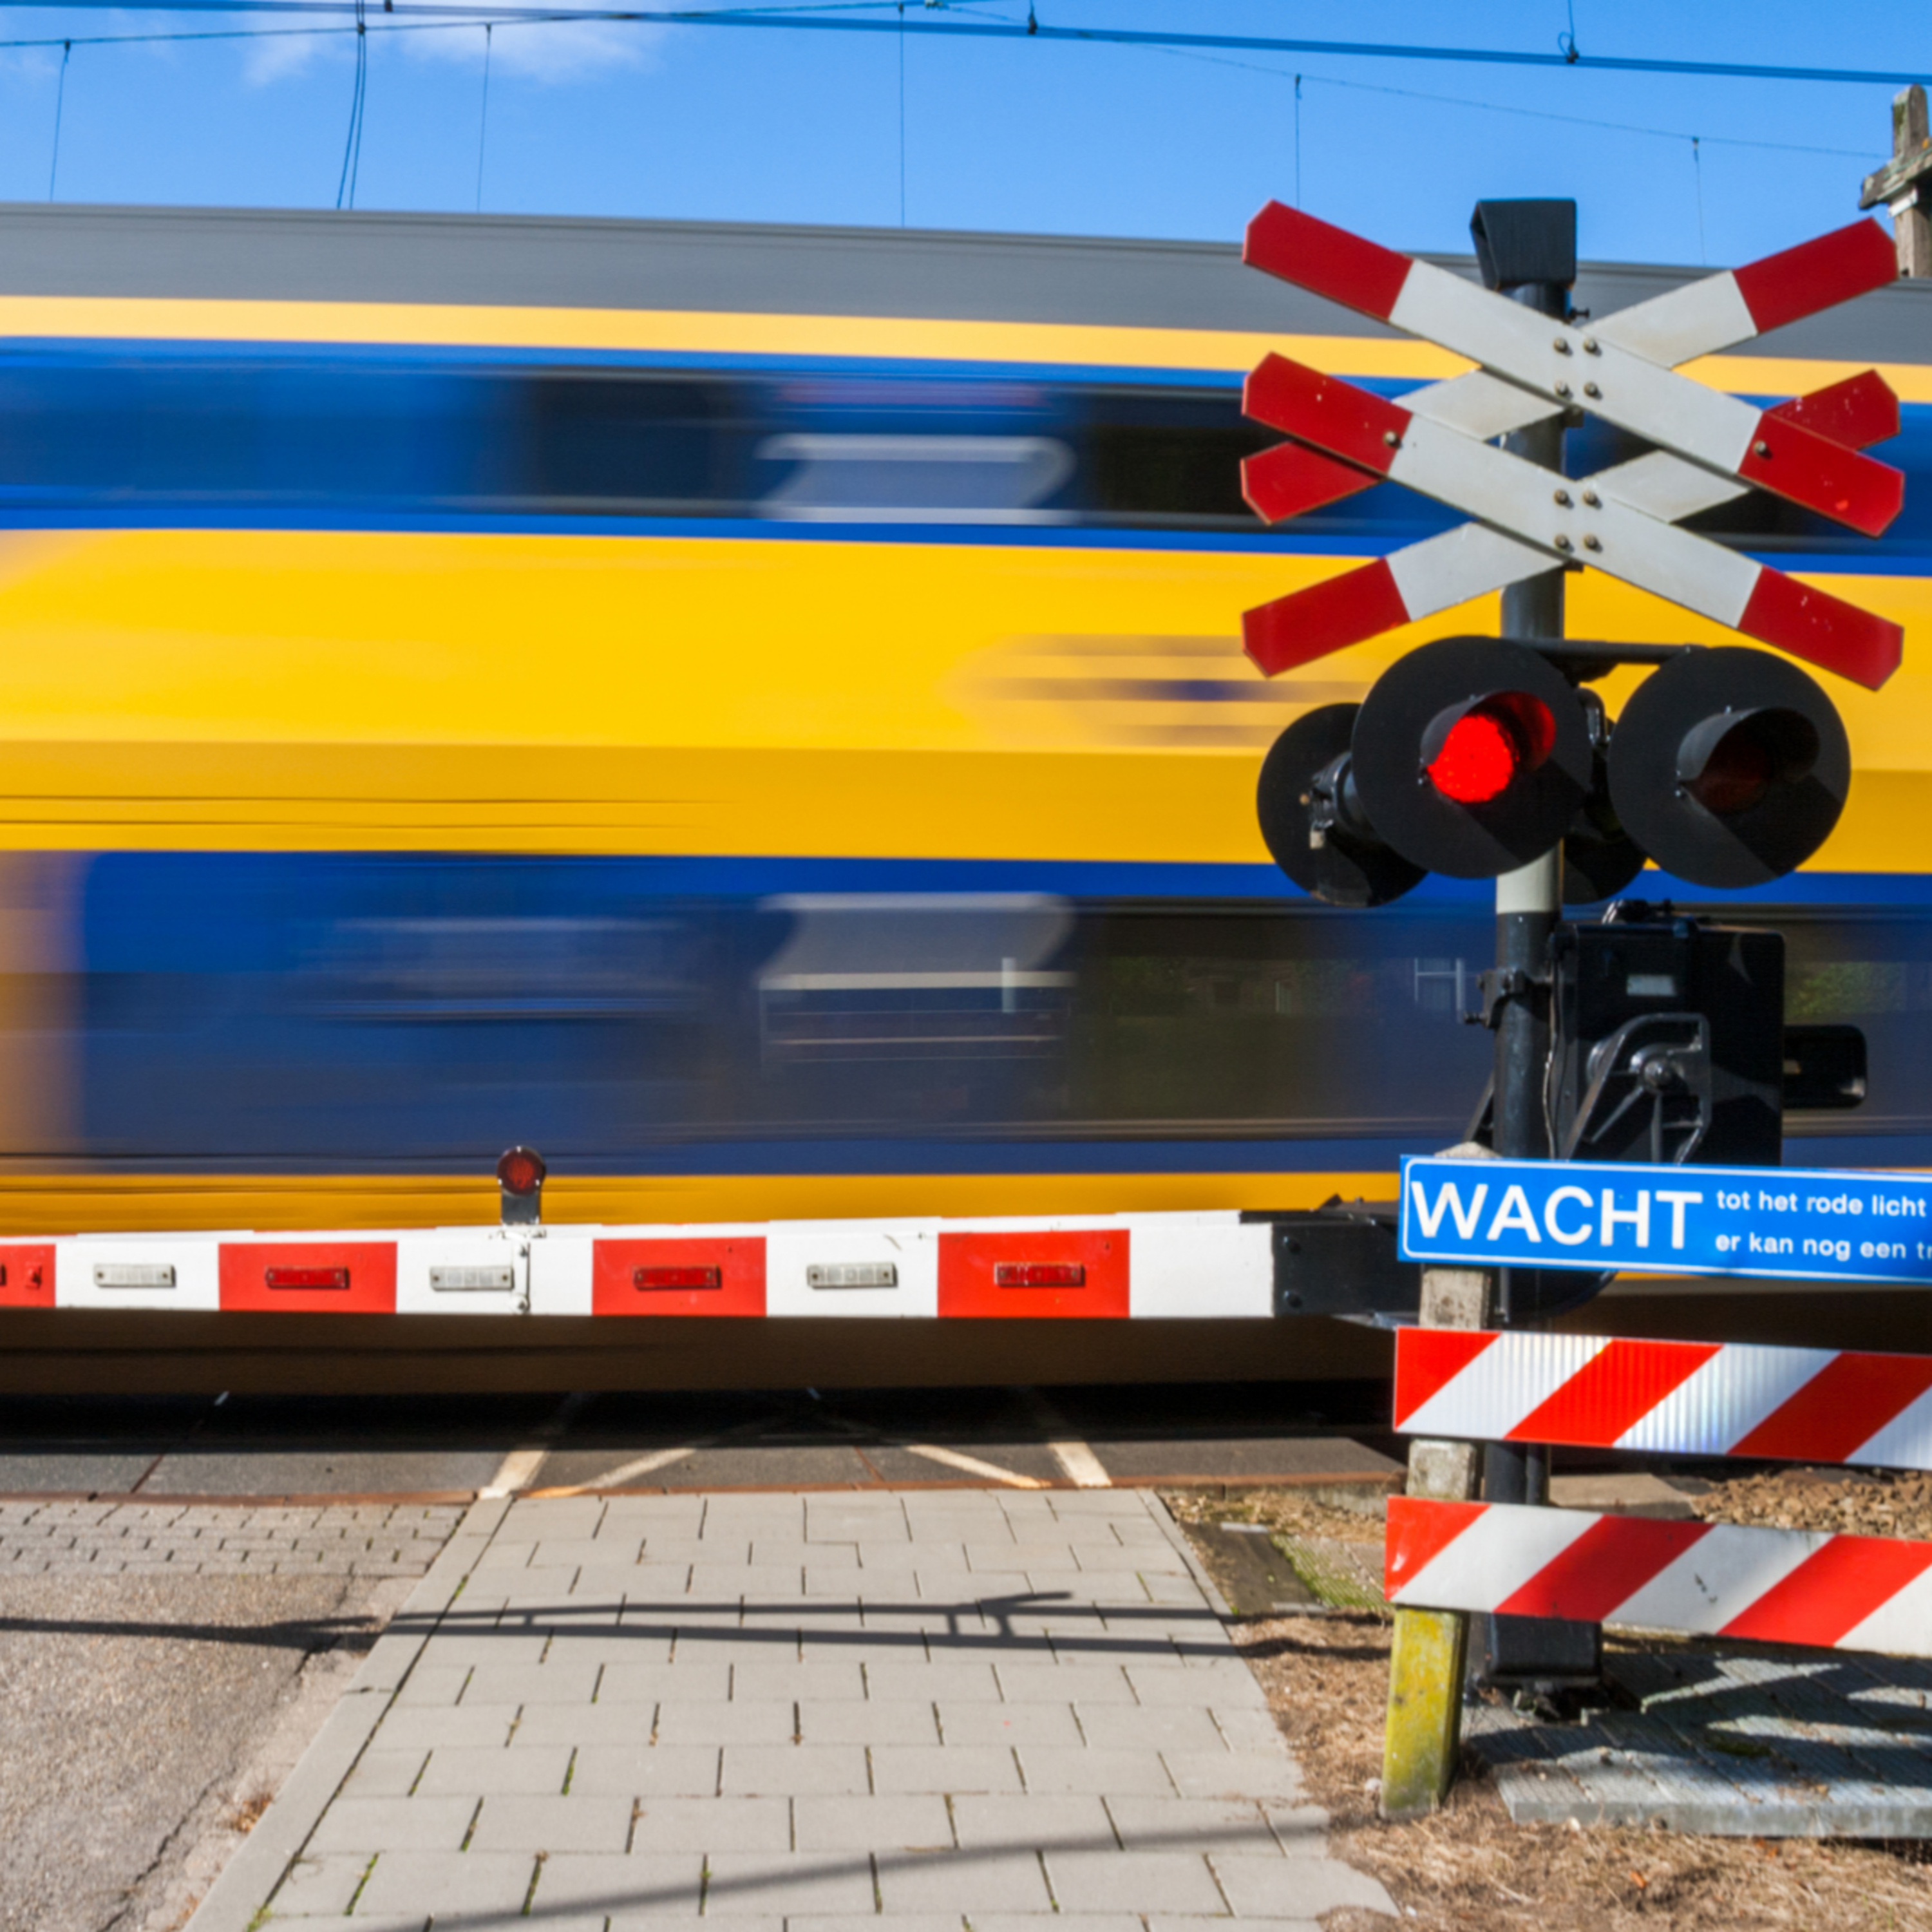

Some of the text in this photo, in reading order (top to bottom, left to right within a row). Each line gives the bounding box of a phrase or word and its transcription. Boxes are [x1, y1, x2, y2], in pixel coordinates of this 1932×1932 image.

[1410, 1181, 1703, 1249] WACHT
[1717, 1191, 1926, 1217] tot het rode licht
[1716, 1235, 1741, 1251] er
[1750, 1233, 1794, 1253] kan
[1803, 1239, 1850, 1262] nog
[1860, 1242, 1906, 1258] een
